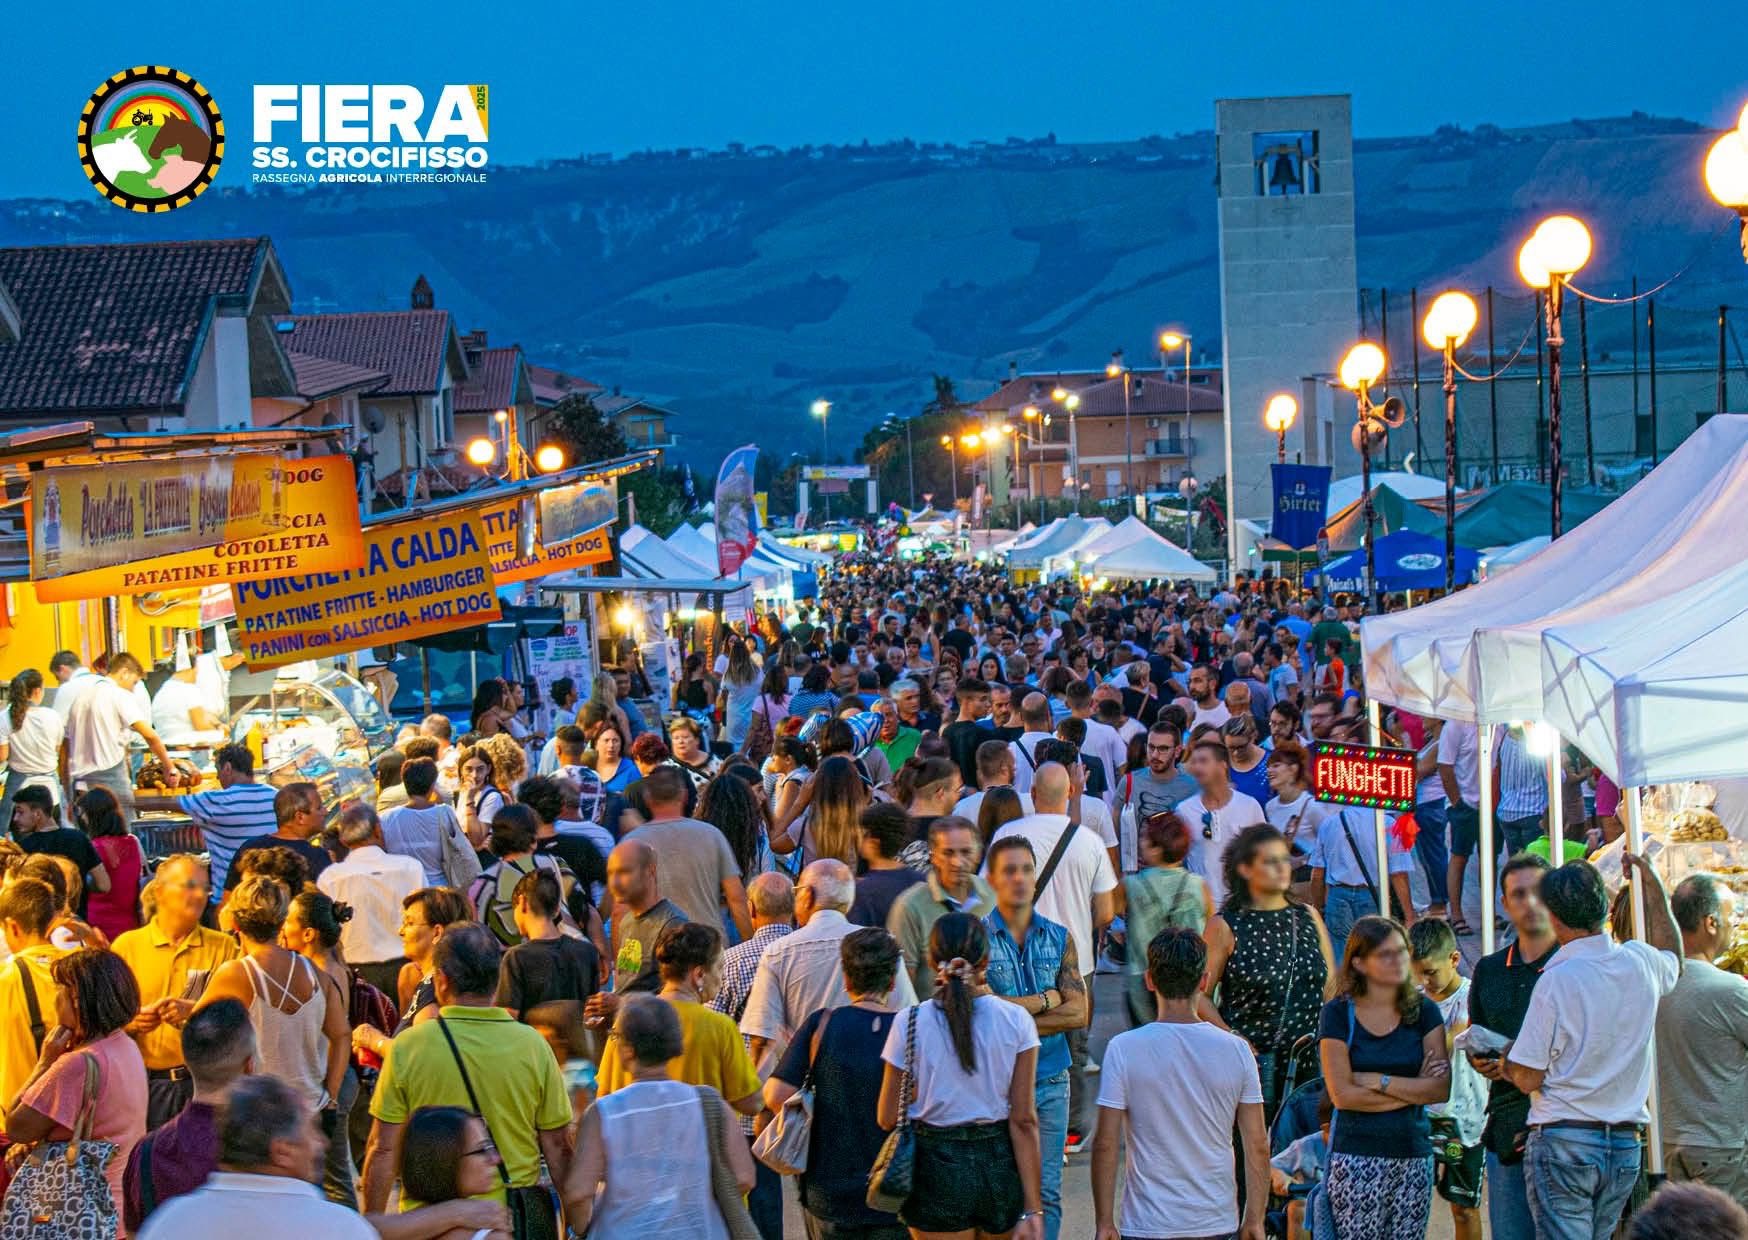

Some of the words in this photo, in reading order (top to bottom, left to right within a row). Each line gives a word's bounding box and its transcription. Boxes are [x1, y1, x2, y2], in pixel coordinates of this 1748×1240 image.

[214, 533, 330, 558] COTOLETTA
[392, 522, 480, 570] CALDA
[547, 544, 573, 561] HOT
[575, 537, 603, 554] DOG
[124, 564, 220, 587] PATATINE
[226, 555, 299, 578] FRITTE
[244, 602, 322, 634] PATATINE
[326, 591, 377, 618] FRITTE
[386, 565, 486, 604] HAMBURGER
[250, 633, 305, 660] PANINI
[332, 610, 411, 643] SALSICCIA
[419, 601, 456, 624] HOT
[456, 591, 493, 615] DOG
[1317, 758, 1413, 798] FUNGHETTI
